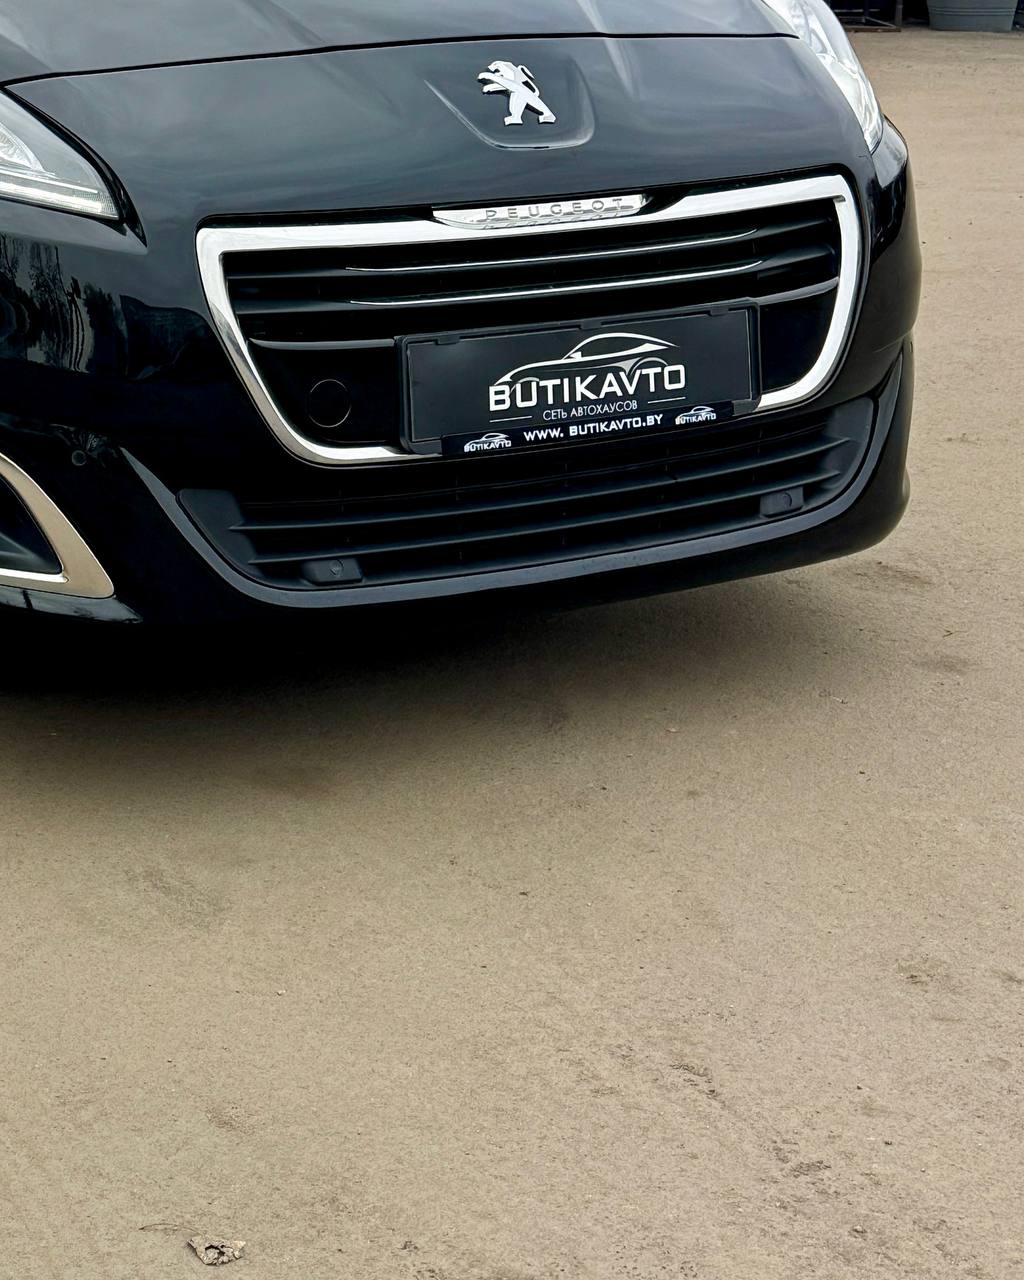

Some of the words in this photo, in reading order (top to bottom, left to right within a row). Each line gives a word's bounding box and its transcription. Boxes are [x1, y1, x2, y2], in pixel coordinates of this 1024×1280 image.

[485, 197, 623, 220] PEUGEOT
[489, 364, 686, 412] BUTIKAVTO
[542, 407, 568, 421] СЕТЬ
[570, 400, 638, 418] АВТОХАУСОВ
[675, 412, 717, 425] BUTIKAVTO
[523, 427, 564, 442] WWW.
[569, 414, 664, 437] BUTIKAVTO.BY
[463, 439, 512, 453] BUTIKAVTO
